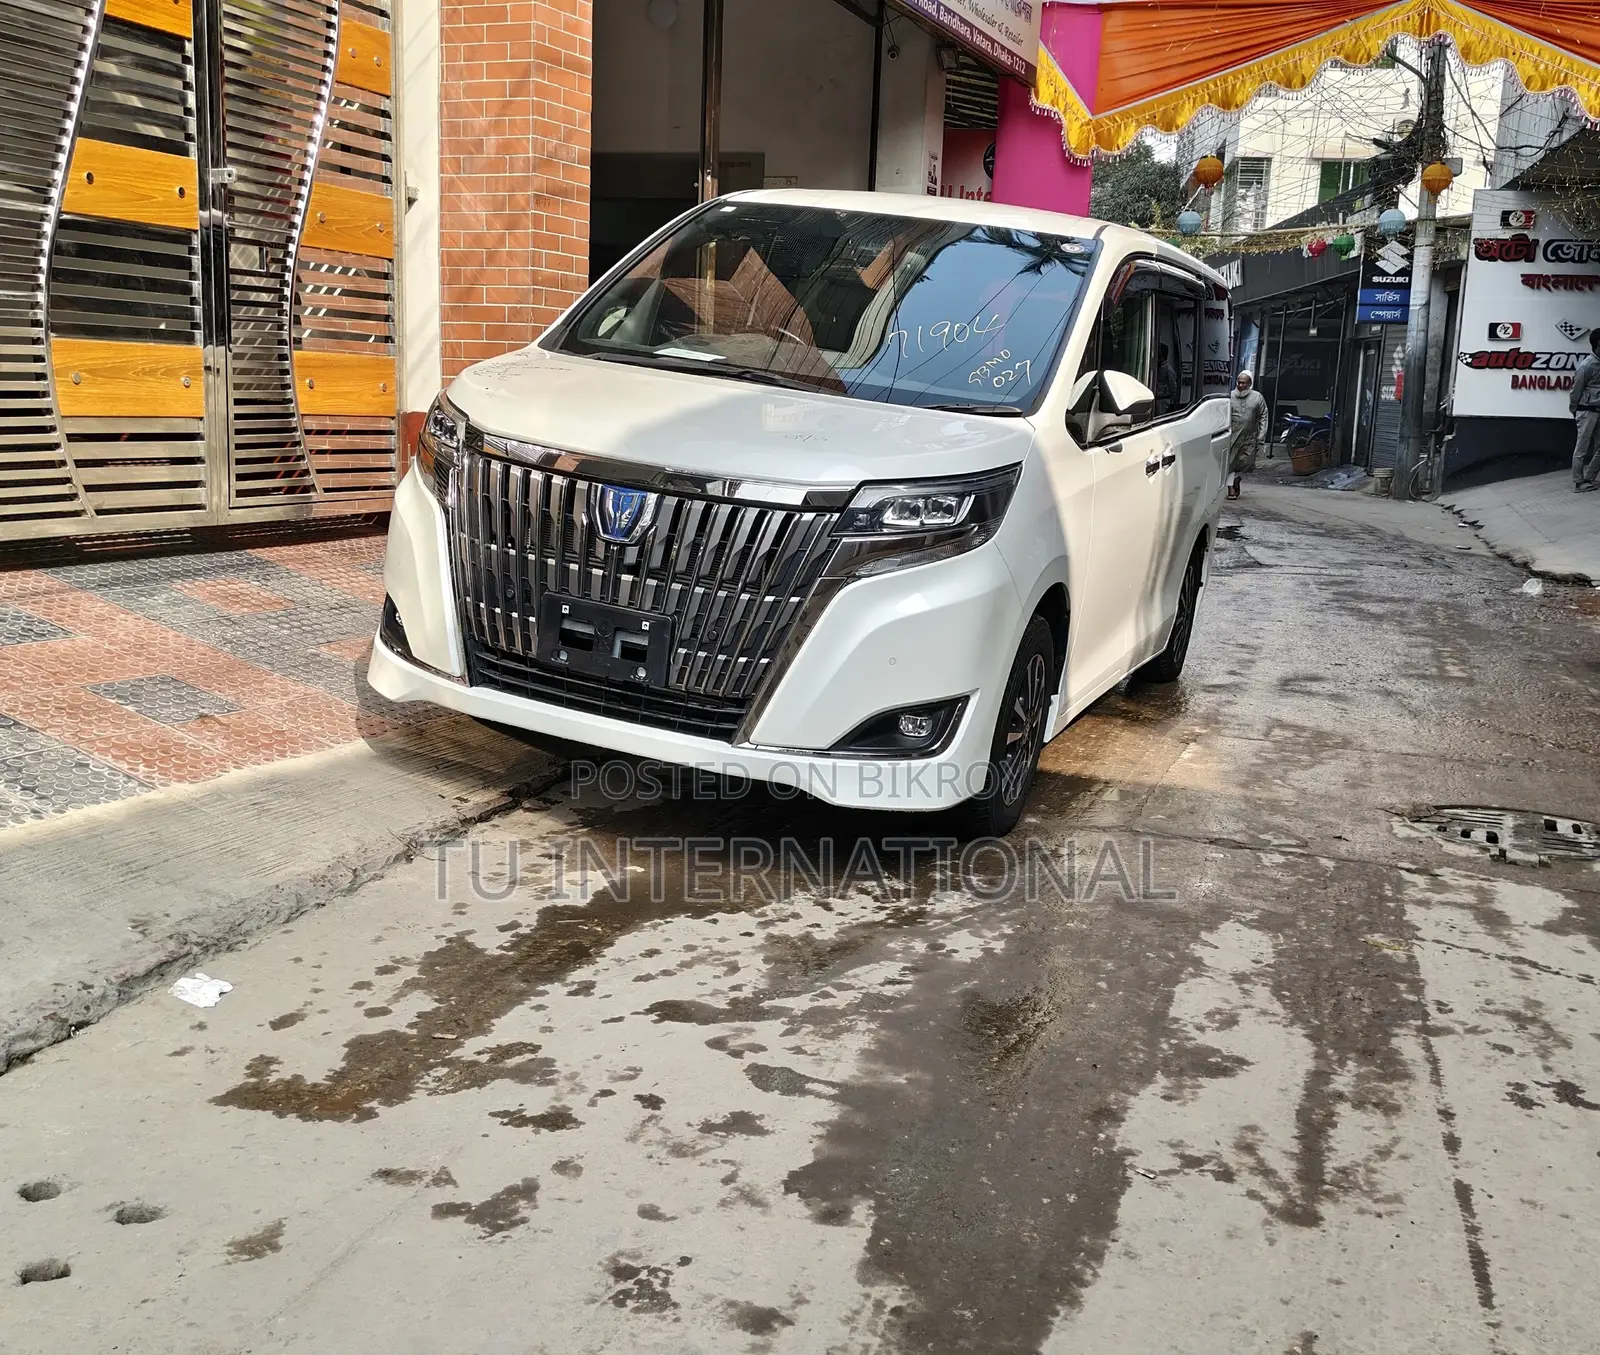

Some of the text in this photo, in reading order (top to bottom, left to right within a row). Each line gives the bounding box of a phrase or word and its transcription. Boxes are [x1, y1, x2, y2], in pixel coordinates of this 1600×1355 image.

[939, 6, 972, 41] Baridhara,
[972, 27, 993, 55] Vatara,
[993, 43, 1026, 75] Dhaka-1212
[1473, 233, 1539, 263] অটো
[1372, 275, 1409, 283] SUZUKI
[1520, 273, 1600, 293] বাংলাদে
[1375, 291, 1401, 303] সার্ভিস
[1370, 308, 1401, 319] স্পেয়ার্স
[888, 314, 1006, 359] 71904
[993, 359, 1031, 388] 027
